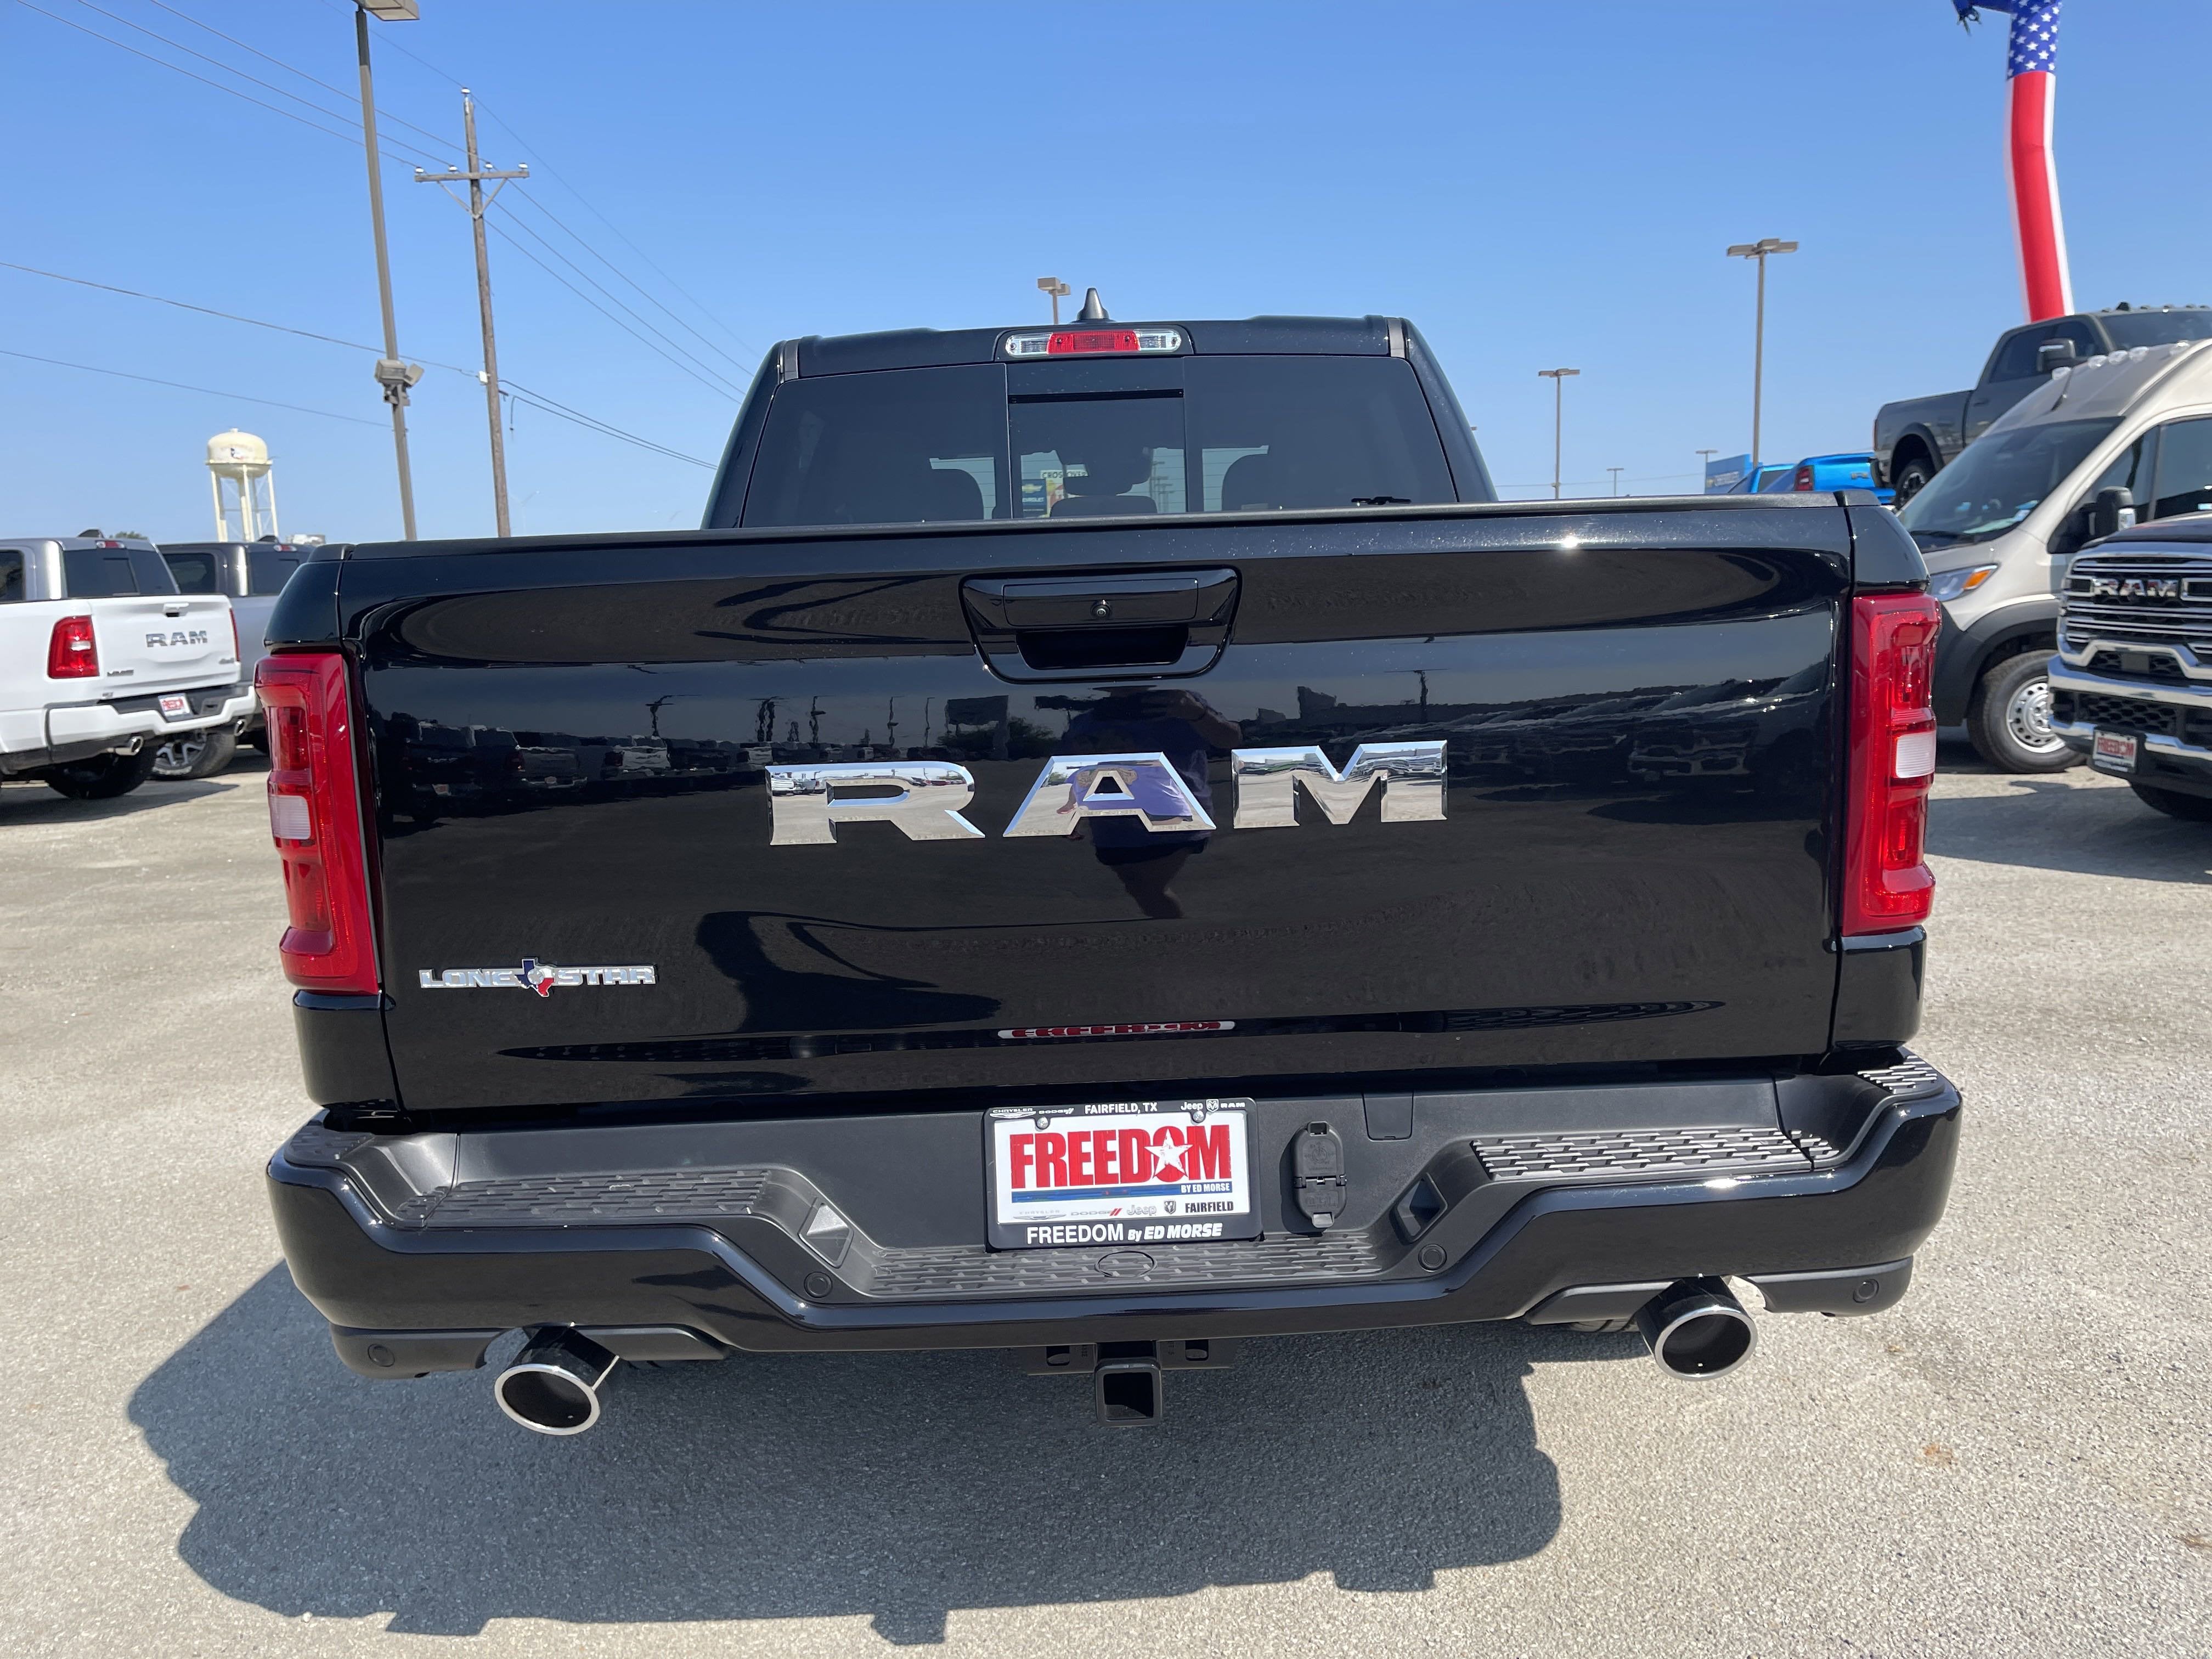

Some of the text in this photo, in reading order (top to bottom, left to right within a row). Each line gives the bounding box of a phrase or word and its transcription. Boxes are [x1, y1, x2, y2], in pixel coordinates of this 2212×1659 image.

[2092, 578, 2179, 597] RAM
[146, 630, 207, 647] RAM
[765, 740, 1448, 845] RAM
[419, 965, 656, 988] LONE STAR
[1085, 1102, 1158, 1114] FAIRFIELD, TX
[1181, 1102, 1203, 1111] Jeep
[1009, 1125, 1232, 1189] FREEDOM
[1181, 1183, 1230, 1193] BY ED MORSE
[1127, 1205, 1157, 1216] Jeep
[1185, 1201, 1234, 1213] FAIRFIELD
[1026, 1223, 1222, 1244] FREEDOM By ED MORSE
